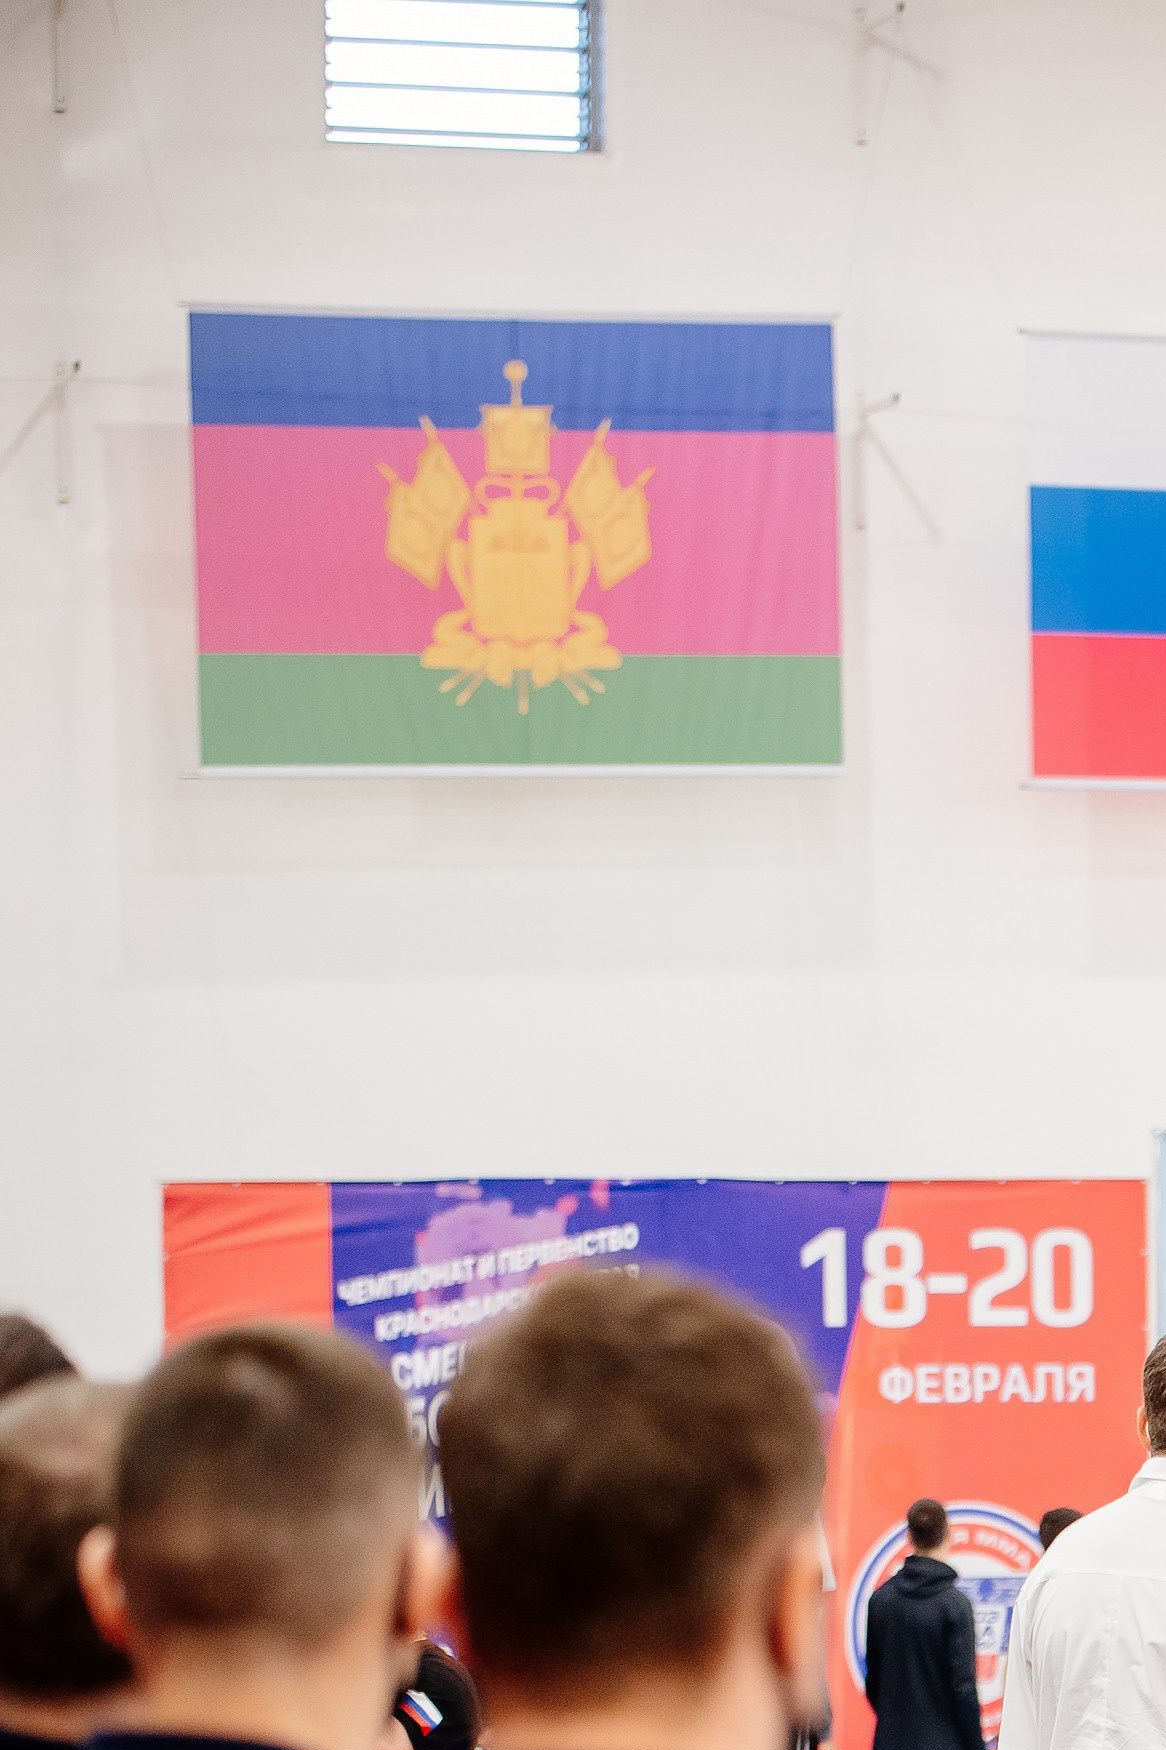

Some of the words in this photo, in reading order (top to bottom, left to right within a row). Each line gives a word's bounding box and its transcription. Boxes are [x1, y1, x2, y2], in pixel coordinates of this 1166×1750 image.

[337, 1256, 476, 1307] ЧЕМПИОНАТ
[475, 1253, 496, 1279] И
[498, 1222, 640, 1277] ПЕРВЕНСТВО
[800, 1226, 1096, 1330] 18-20
[391, 1340, 467, 1391] СМЕ
[878, 1361, 1096, 1404] ФЕВРАЛЯ
